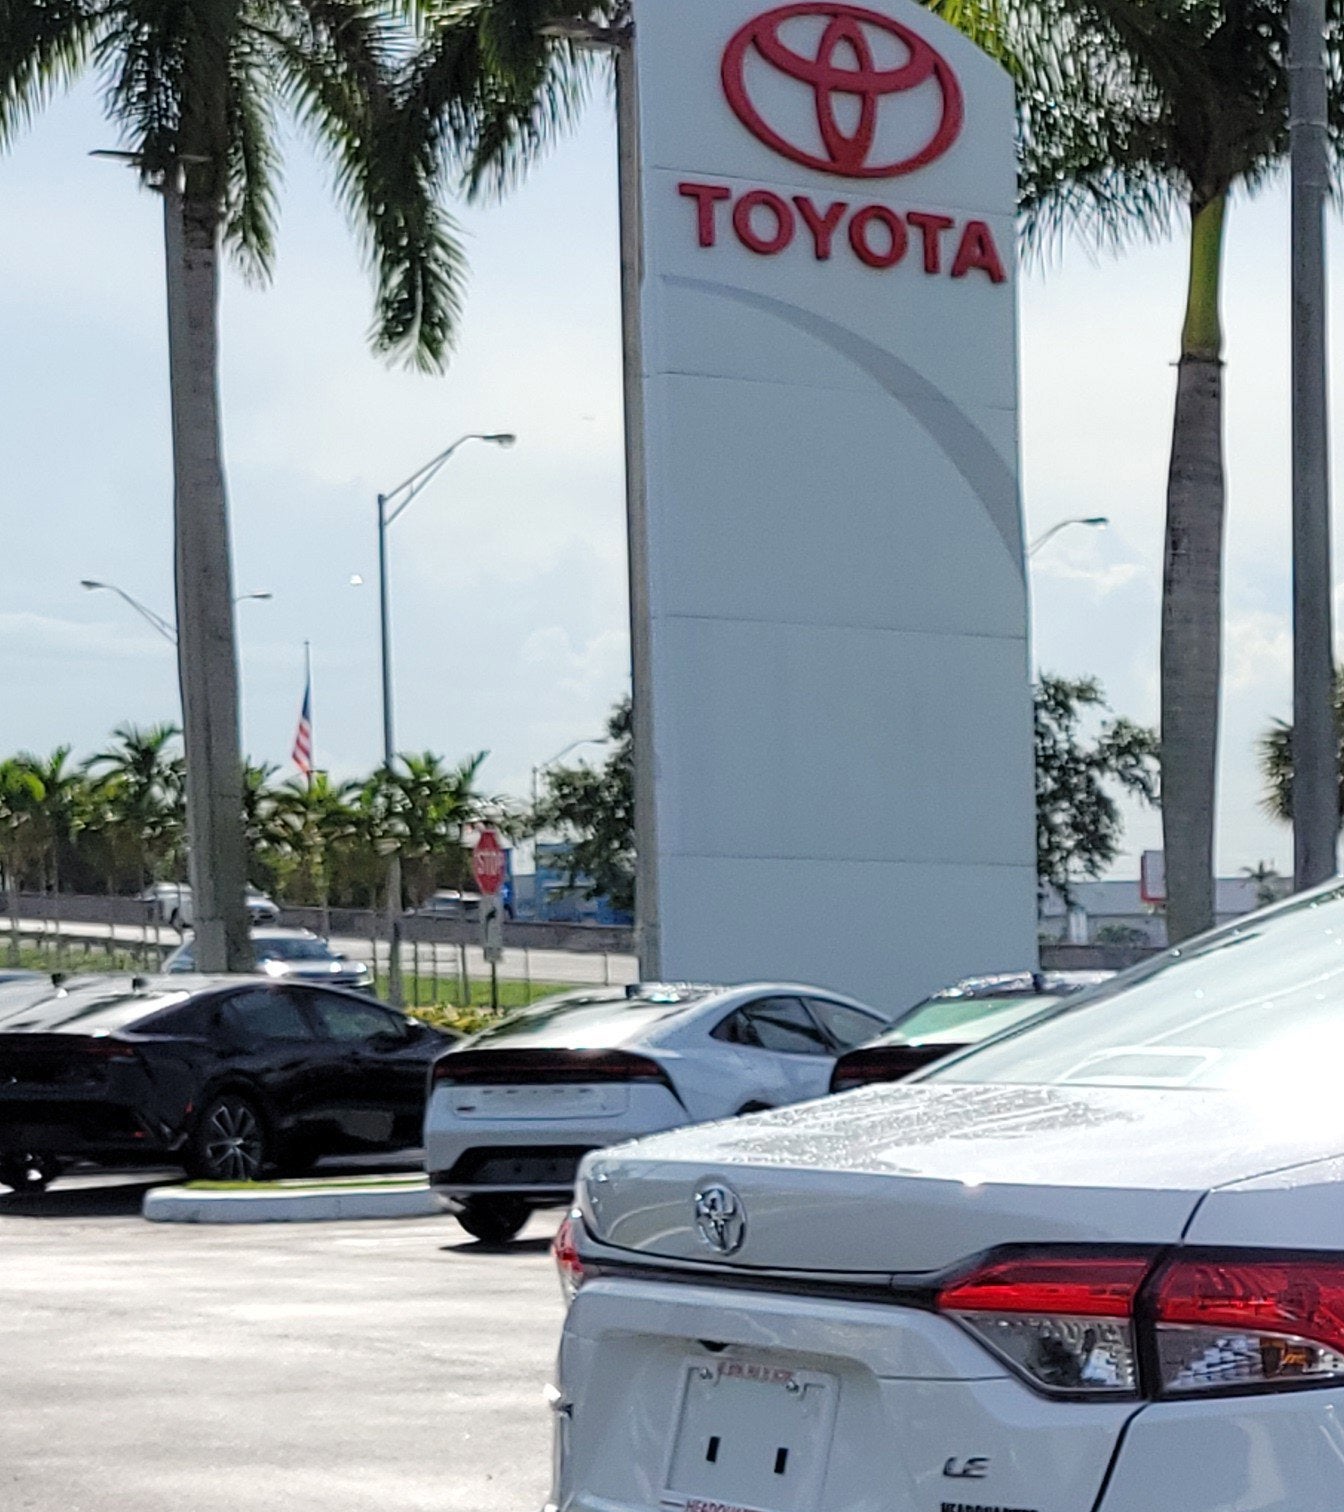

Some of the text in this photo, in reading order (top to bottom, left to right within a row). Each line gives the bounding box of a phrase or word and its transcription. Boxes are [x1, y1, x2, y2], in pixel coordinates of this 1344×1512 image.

[678, 181, 1007, 284] TOYOTA
[474, 852, 503, 876] STOP
[943, 1456, 990, 1478] LE
